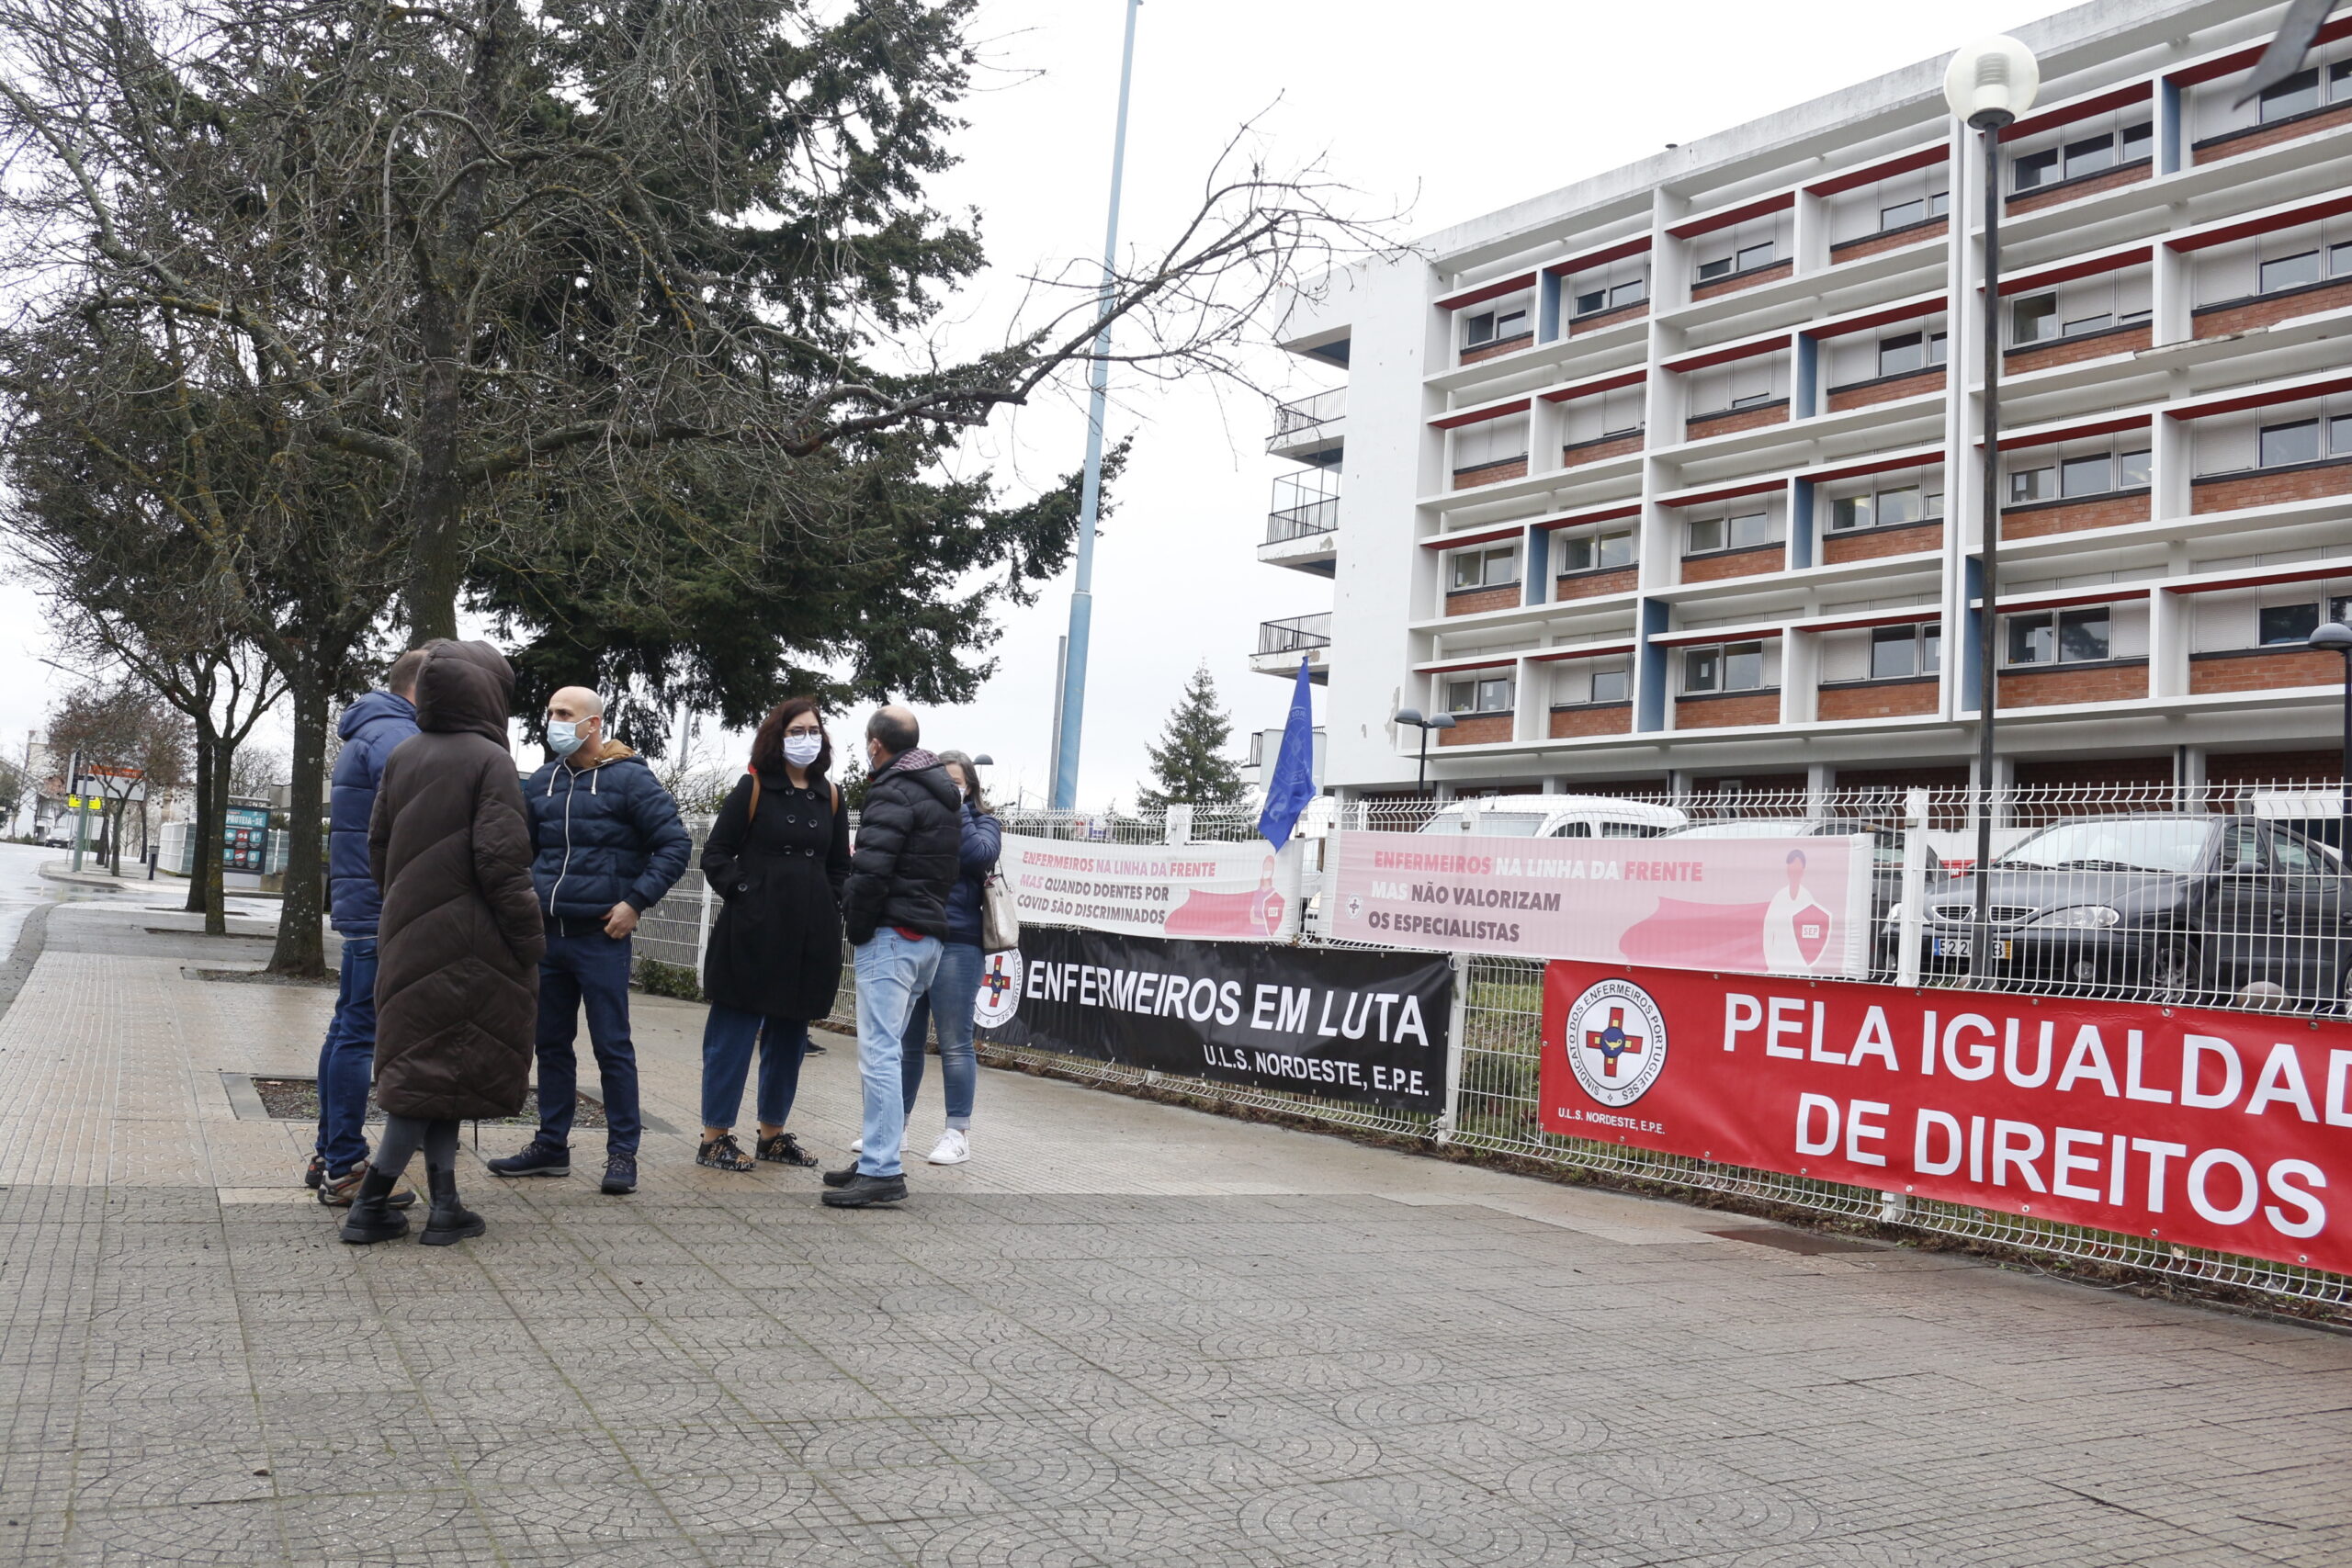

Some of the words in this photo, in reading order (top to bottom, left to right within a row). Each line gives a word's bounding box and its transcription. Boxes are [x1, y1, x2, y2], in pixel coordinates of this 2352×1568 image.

[1023, 851, 1095, 873] ENFERMEIROS
[1096, 859, 1112, 874] NA
[1114, 860, 1148, 876] LINHA
[1150, 862, 1167, 876] DA
[1170, 862, 1216, 877] FRENTE
[1374, 851, 1493, 875] ENFERMEIROS
[1495, 857, 1522, 877] NA
[1526, 859, 1586, 880] LINHA
[1589, 860, 1620, 880] DA
[1624, 861, 1703, 882] FRENTE
[1020, 874, 1045, 889] MAS
[1045, 877, 1091, 897] QUANDO
[1093, 883, 1143, 900] DOENTES
[1145, 886, 1170, 901] POR
[1371, 880, 1408, 901] MAS
[1411, 881, 1449, 904] NÃO
[1453, 886, 1561, 912] VALORIZAM
[1017, 894, 1049, 911] COVID
[1050, 897, 1073, 916] SÃO
[1074, 903, 1166, 925] DISCRIMINADOS
[1368, 910, 1390, 930] OS
[1394, 913, 1520, 942] ESPECIALISTAS
[1804, 927, 1818, 936] SEP
[1026, 960, 1241, 1026] ENFERMEIROS
[1250, 984, 1312, 1034] EM
[1317, 990, 1430, 1047] LUTA
[1583, 983, 1655, 1015] ENFERMEIROS
[1570, 1004, 1584, 1031] DOS
[1724, 992, 1899, 1071] PELA
[1204, 1044, 1252, 1072] U.L.S.
[1255, 1051, 1368, 1091] NORDESTE,
[1373, 1065, 1430, 1096] E.P.E.
[1568, 1034, 1600, 1097] SINDICATO
[1622, 1015, 1664, 1100] PORTUGUESES
[1557, 1107, 1584, 1121] U.L.S.
[1586, 1111, 1639, 1132] NORDESTE,
[1640, 1120, 1666, 1134] E.P.E.
[1795, 1092, 1890, 1167] DE
[1914, 1108, 2327, 1238] DIREITOS
